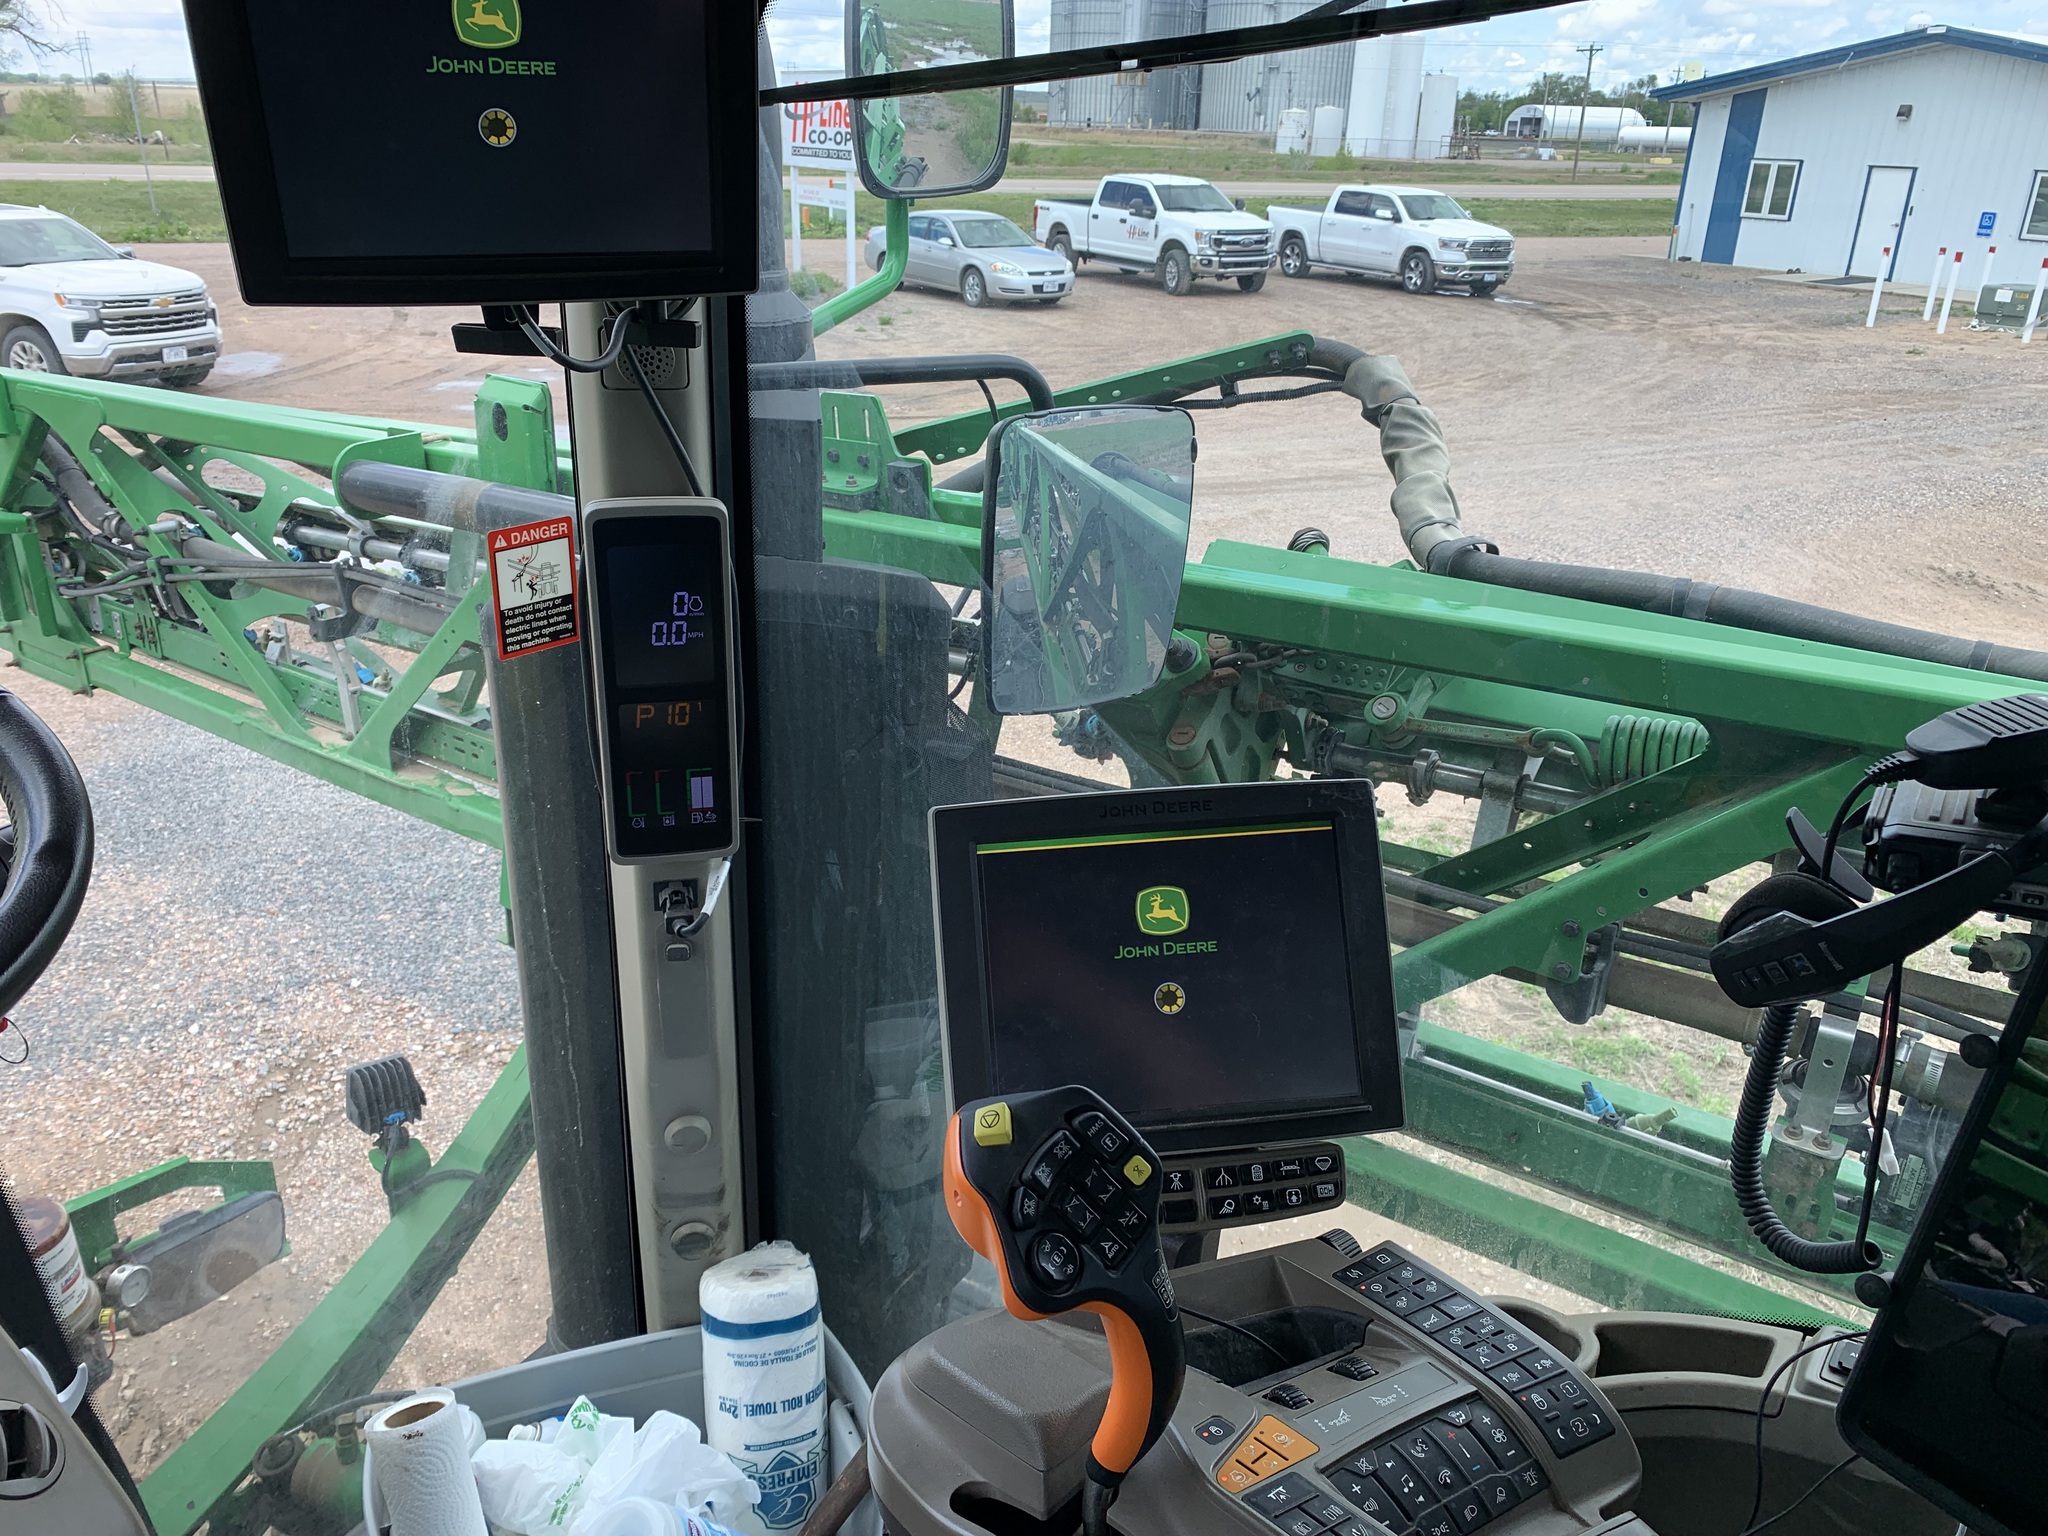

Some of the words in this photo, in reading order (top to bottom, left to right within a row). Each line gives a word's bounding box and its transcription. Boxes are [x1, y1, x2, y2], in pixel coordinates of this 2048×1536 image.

[426, 56, 483, 73] JOHN
[488, 57, 556, 75] DEERE
[808, 130, 852, 146] CO-OP
[792, 147, 829, 158] COMMITTED
[829, 150, 838, 158] TO
[511, 522, 568, 545] DANGER
[514, 603, 533, 615] avoid
[534, 599, 553, 611] injury
[673, 591, 689, 616] 0
[504, 615, 524, 626] death
[525, 613, 534, 621] do
[535, 611, 547, 619] not
[547, 604, 573, 616] contact
[505, 623, 531, 635] electric
[531, 618, 548, 629] lines
[549, 614, 567, 624] when
[506, 630, 532, 644] moving
[532, 629, 541, 637] or
[541, 622, 573, 636] operating
[651, 621, 687, 646] 0.0
[506, 642, 520, 652] this
[521, 636, 552, 648] machine.
[636, 704, 655, 729] P
[667, 702, 690, 726] 10
[1099, 804, 1147, 818] JOHN
[1153, 800, 1213, 814] DEERE
[1114, 945, 1160, 959] JOHN
[1162, 941, 1218, 955] DEERE
[1087, 1119, 1104, 1137] HMS
[1105, 1138, 1113, 1148] F
[1053, 1254, 1062, 1263] E
[1108, 1244, 1119, 1259] AUTO
[1480, 1324, 1495, 1334] AUTO
[1507, 1343, 1518, 1351] B
[733, 1359, 758, 1367] COCINA
[760, 1359, 769, 1367] DE
[770, 1355, 794, 1365] TOALLA
[795, 1353, 802, 1361] DE
[1479, 1355, 1491, 1364] A
[1502, 1375, 1509, 1383] 1
[1565, 1385, 1573, 1394] 1
[744, 1402, 778, 1417] TOWEL
[780, 1397, 803, 1413] ROLL
[1574, 1422, 1584, 1432] 2
